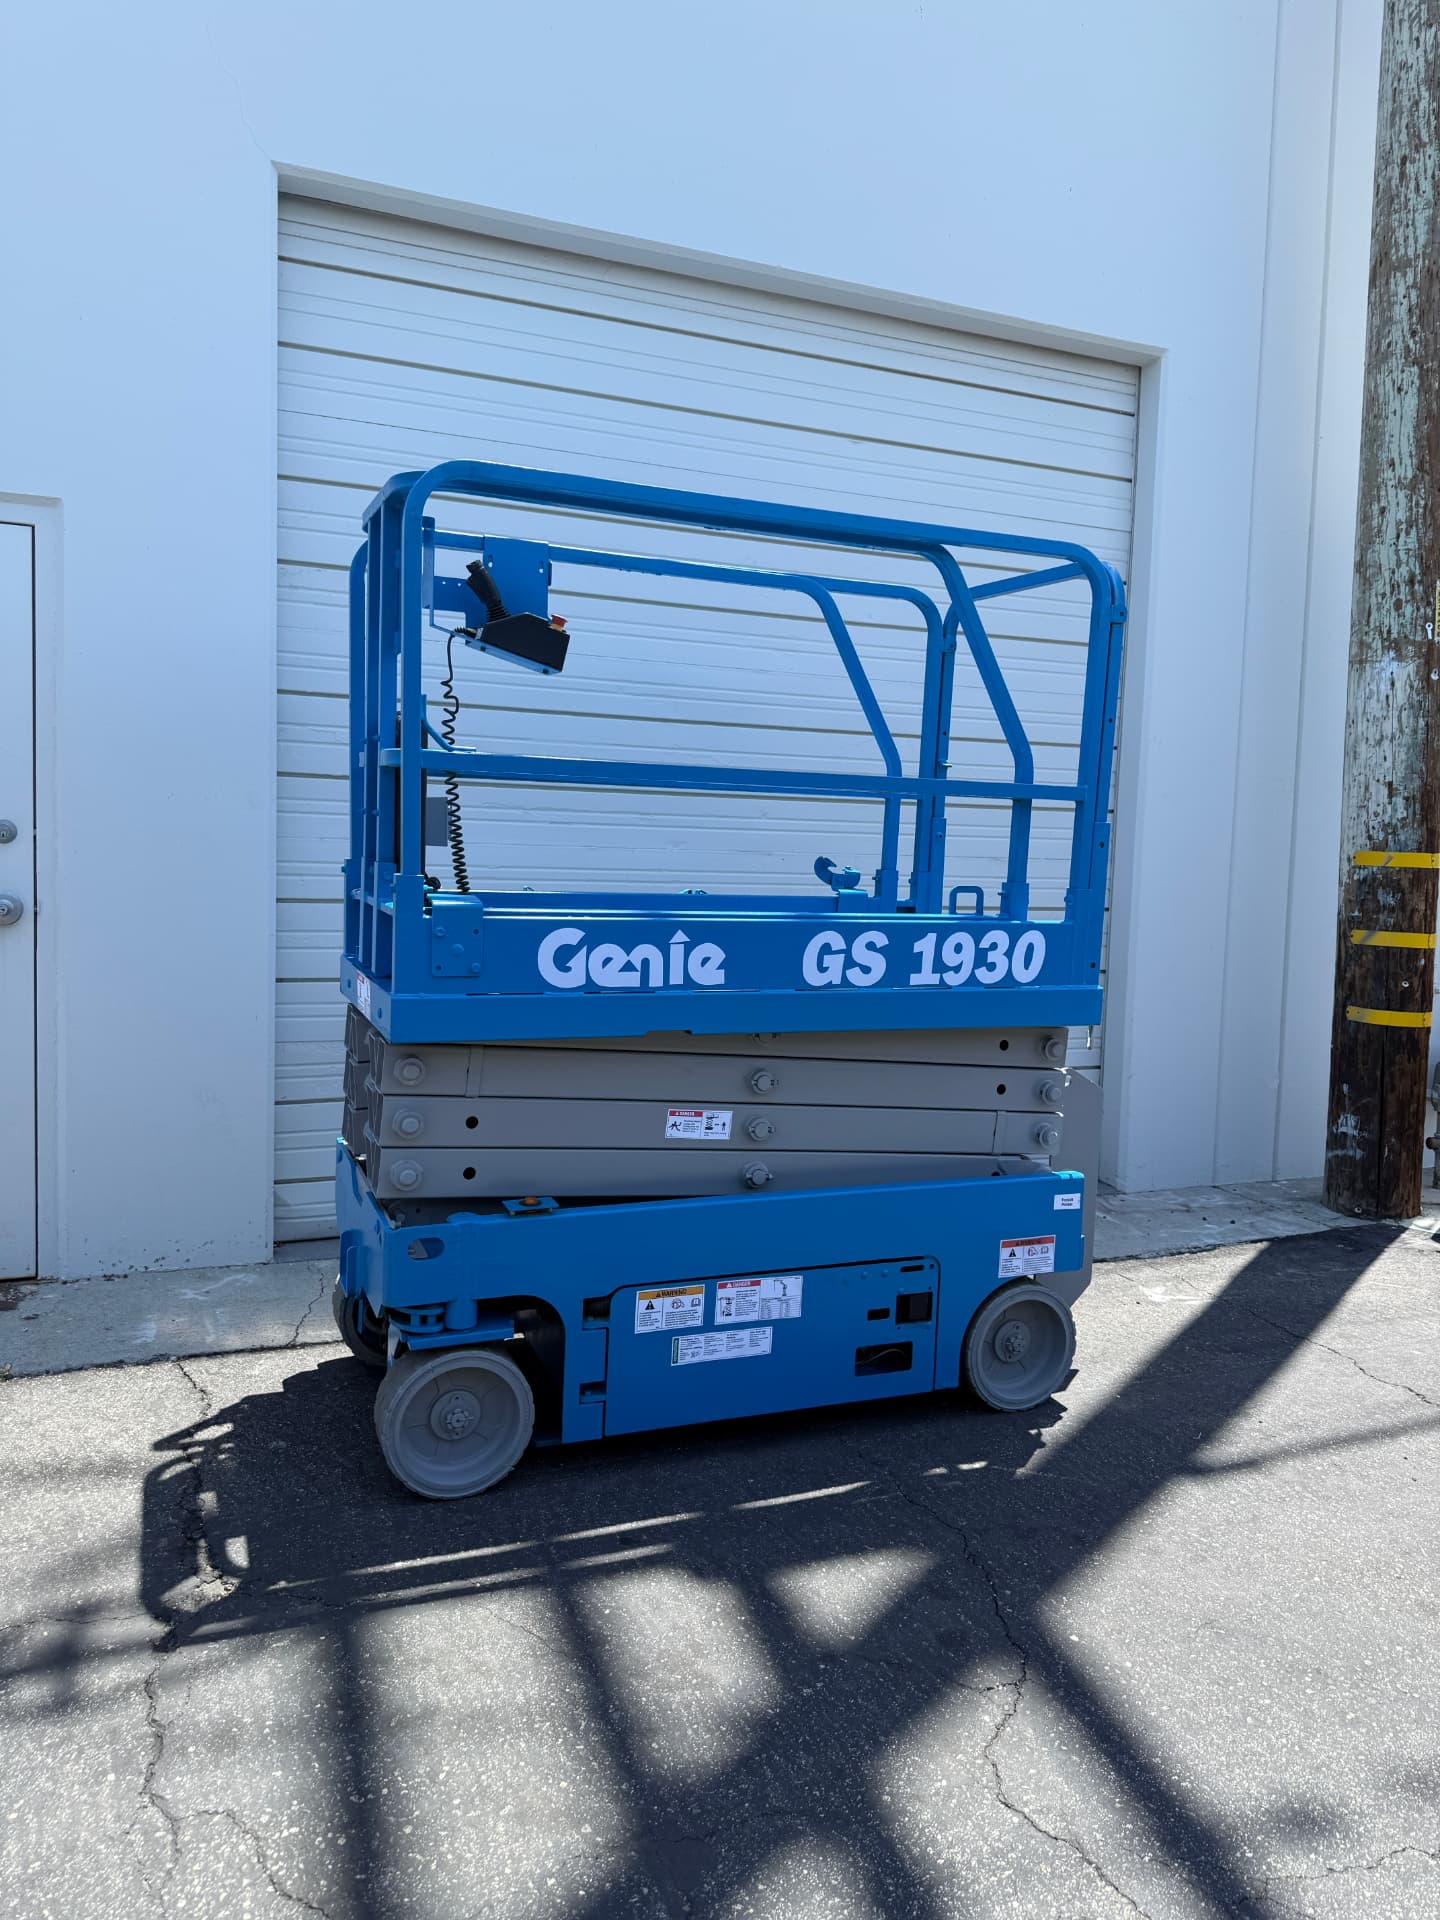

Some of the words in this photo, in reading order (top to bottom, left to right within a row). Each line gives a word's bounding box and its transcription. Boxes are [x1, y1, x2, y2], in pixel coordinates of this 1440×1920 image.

[538, 928, 725, 988] Genie
[803, 931, 889, 986] GS
[910, 930, 1046, 985] 1930
